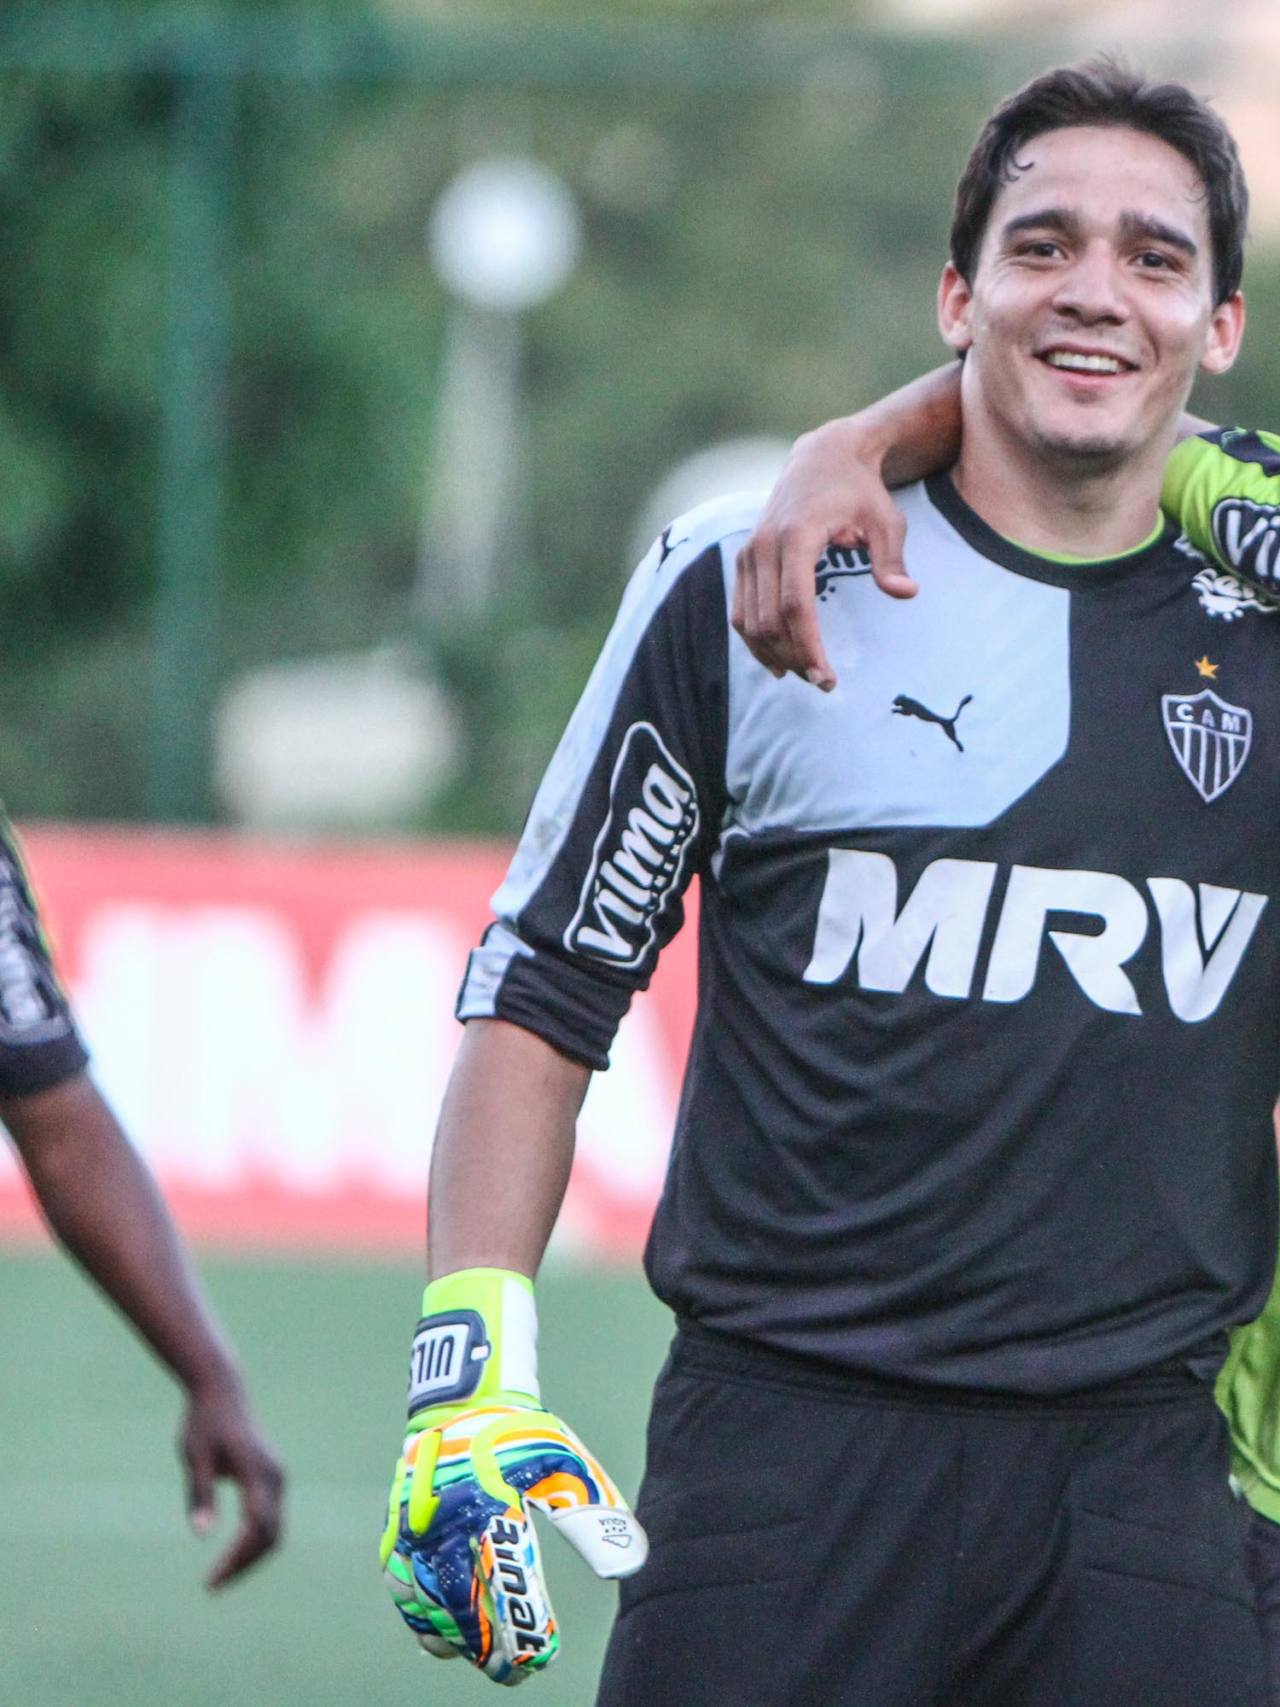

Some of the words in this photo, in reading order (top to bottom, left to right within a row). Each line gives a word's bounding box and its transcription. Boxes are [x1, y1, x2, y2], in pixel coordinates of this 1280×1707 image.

[1176, 703, 1240, 733] CAM
[577, 763, 690, 957] Vilma
[802, 848, 1268, 1023] MRV
